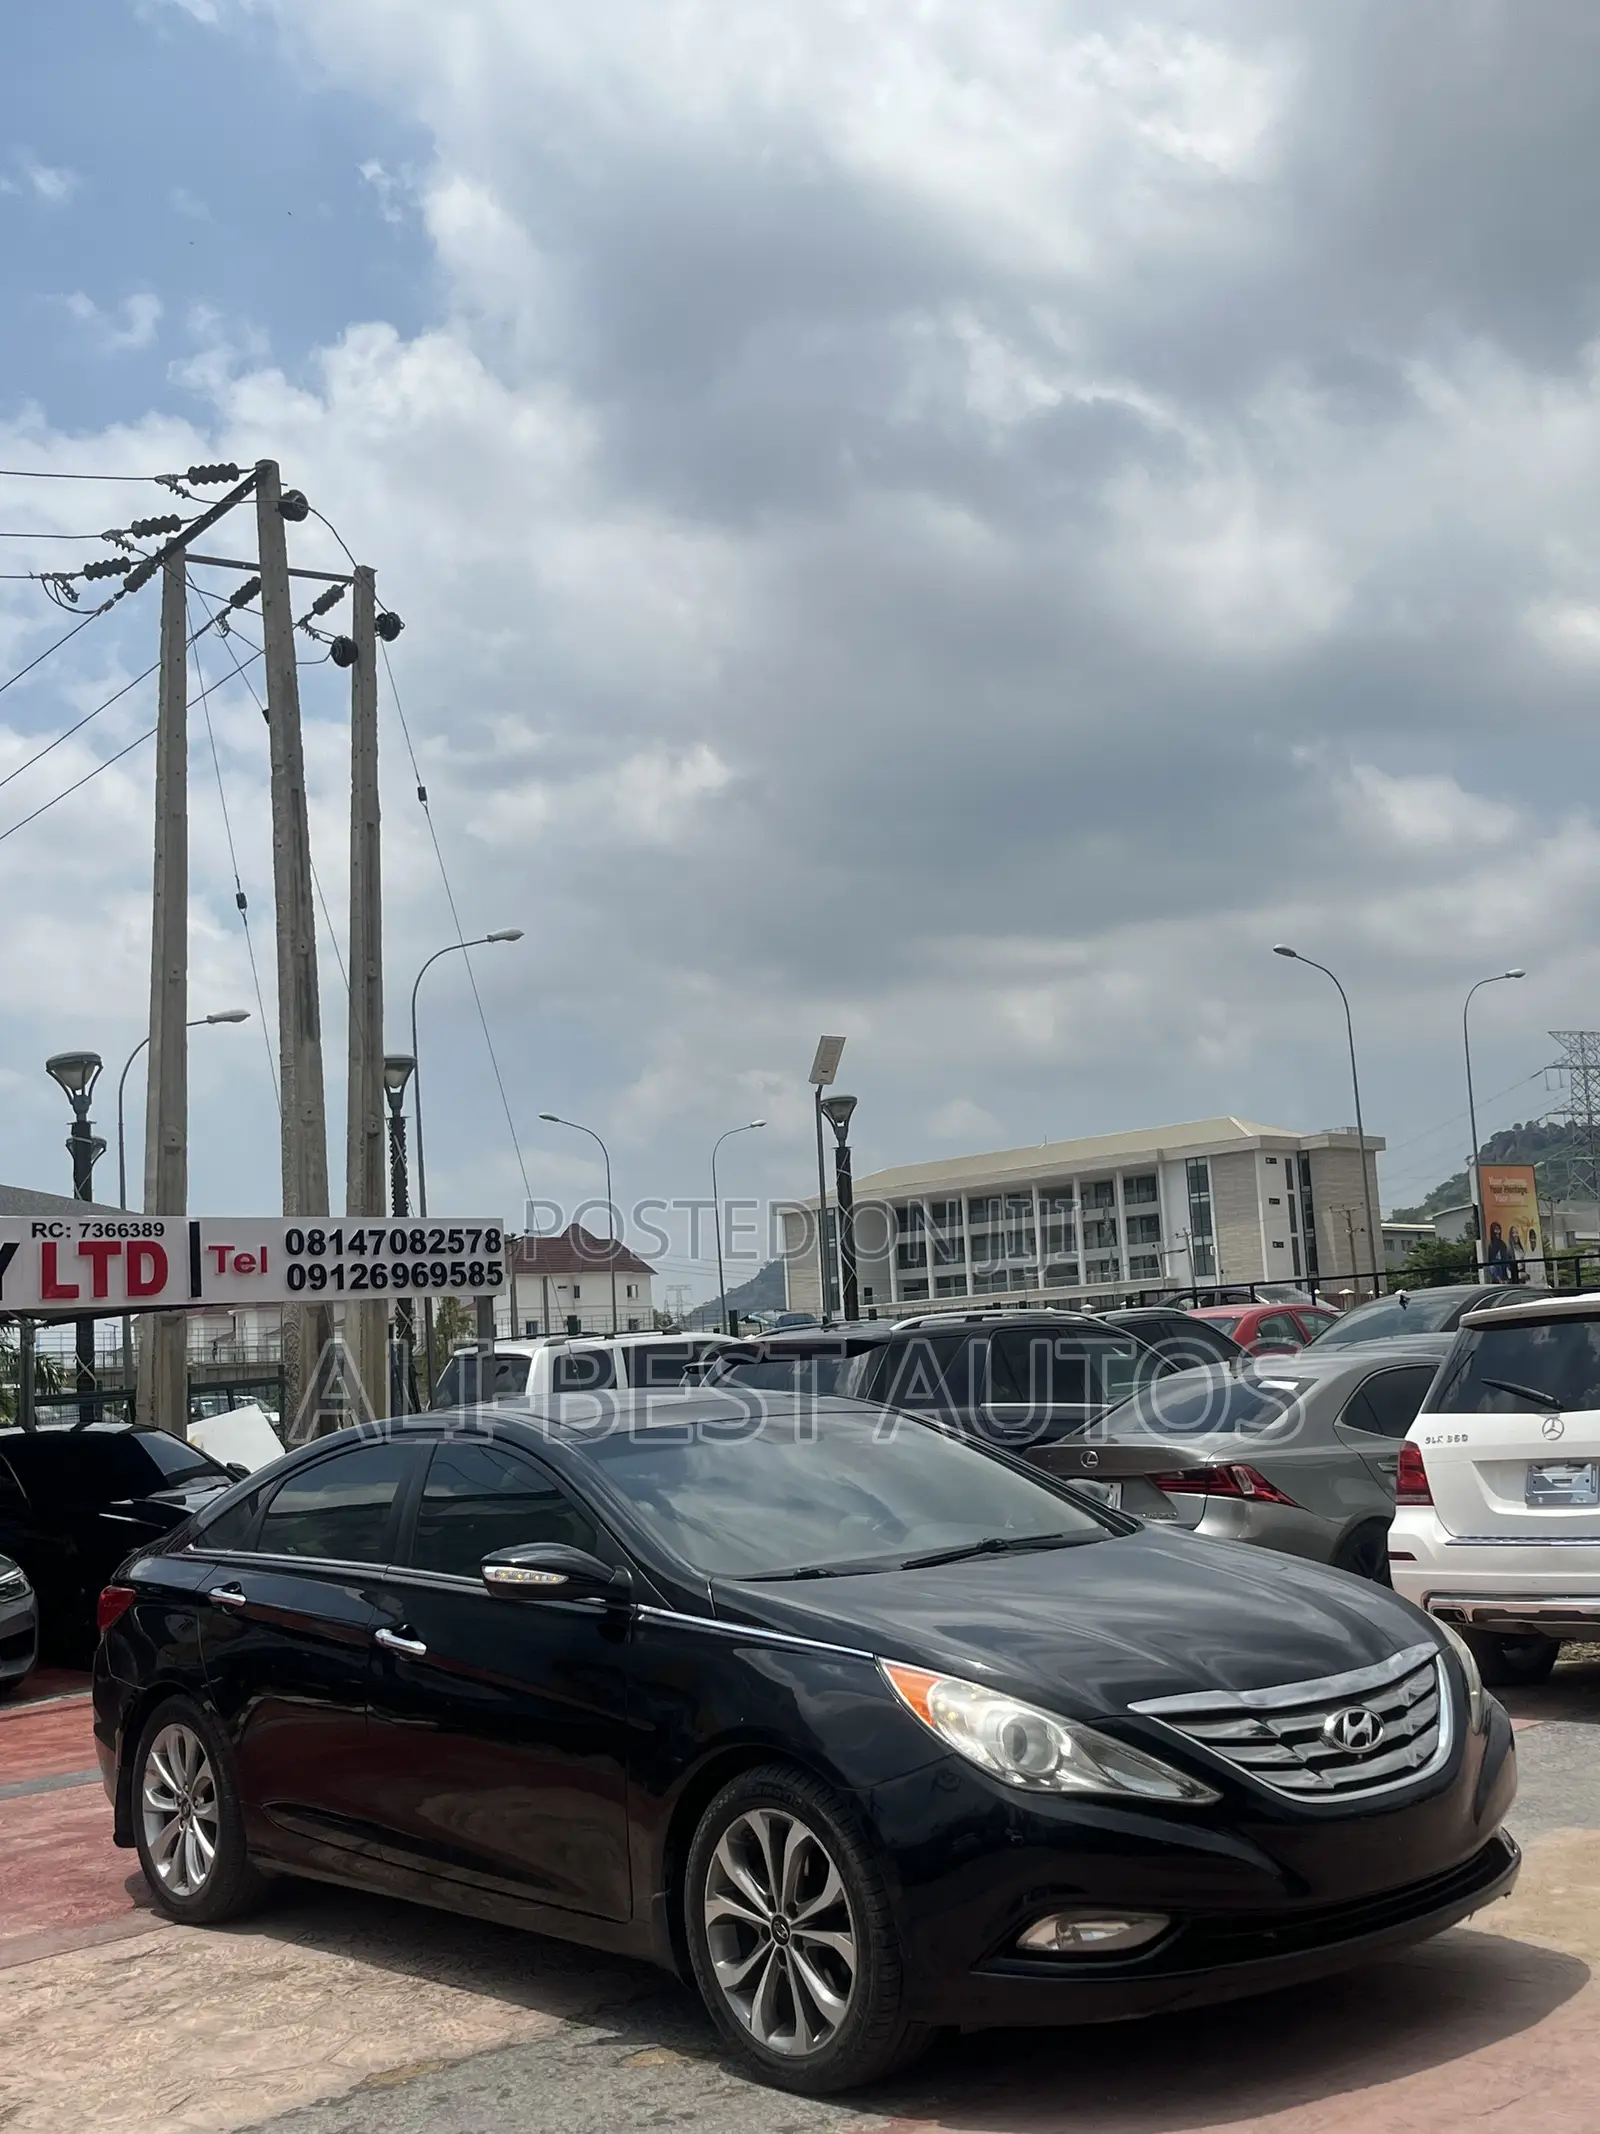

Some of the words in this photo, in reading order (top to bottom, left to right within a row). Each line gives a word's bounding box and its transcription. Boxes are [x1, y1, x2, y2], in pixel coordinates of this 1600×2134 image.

[31, 1222, 71, 1238] RC:
[78, 1222, 165, 1238] 7366389
[285, 1228, 502, 1256] 08147082578
[41, 1240, 169, 1299] LTD
[208, 1245, 268, 1274] Tel
[287, 1261, 504, 1291] 09126969585
